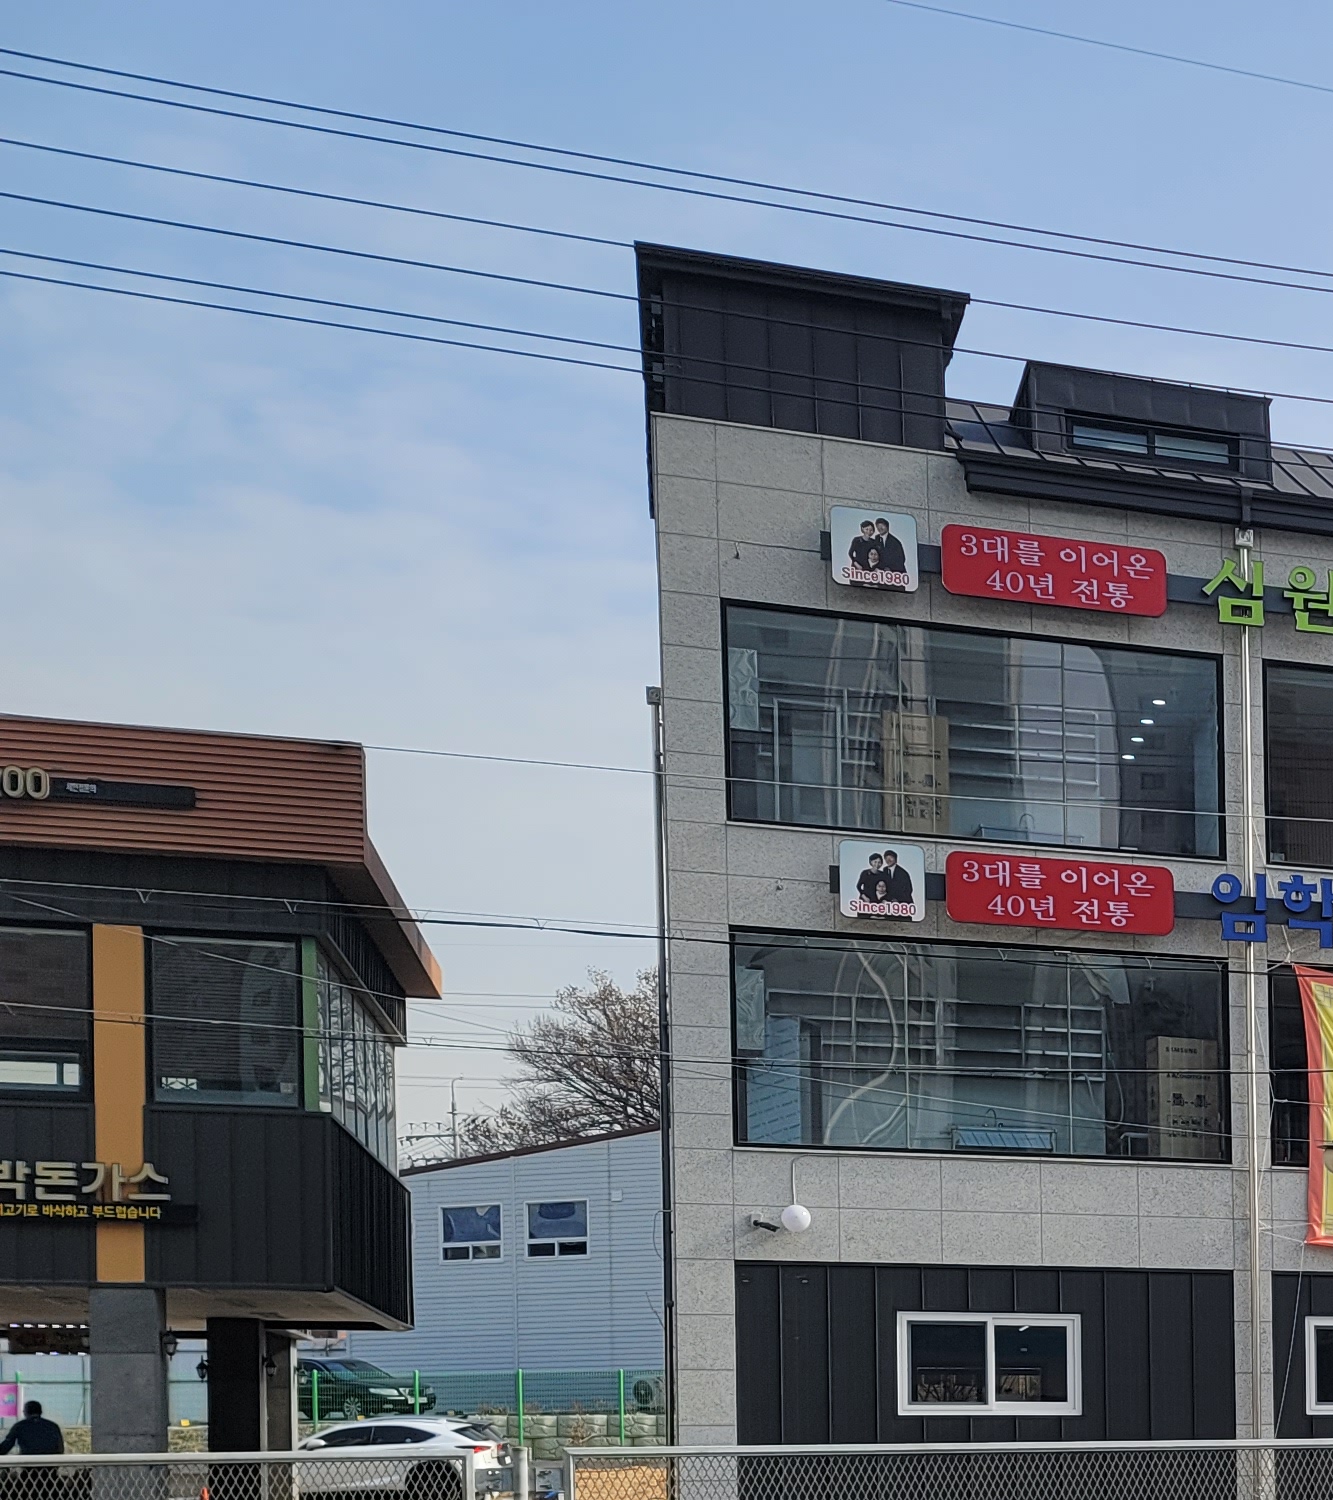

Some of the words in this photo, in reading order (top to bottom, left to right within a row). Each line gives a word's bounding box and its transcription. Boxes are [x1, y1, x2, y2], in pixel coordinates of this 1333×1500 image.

[960, 534, 1046, 568] 3대를
[1059, 546, 1155, 579] 이어온
[842, 566, 910, 586] Since1980
[986, 569, 1056, 600] 40년
[1070, 578, 1135, 609] 전통
[0, 764, 50, 800] 00
[962, 860, 1048, 890] 3대를
[1060, 867, 1156, 898] 이어온
[849, 899, 917, 917] Since1980
[987, 893, 1057, 922] 40년
[1071, 899, 1135, 927] 전통
[0, 1202, 40, 1217] 고기로
[92, 1204, 162, 1219] 부드럽습니다
